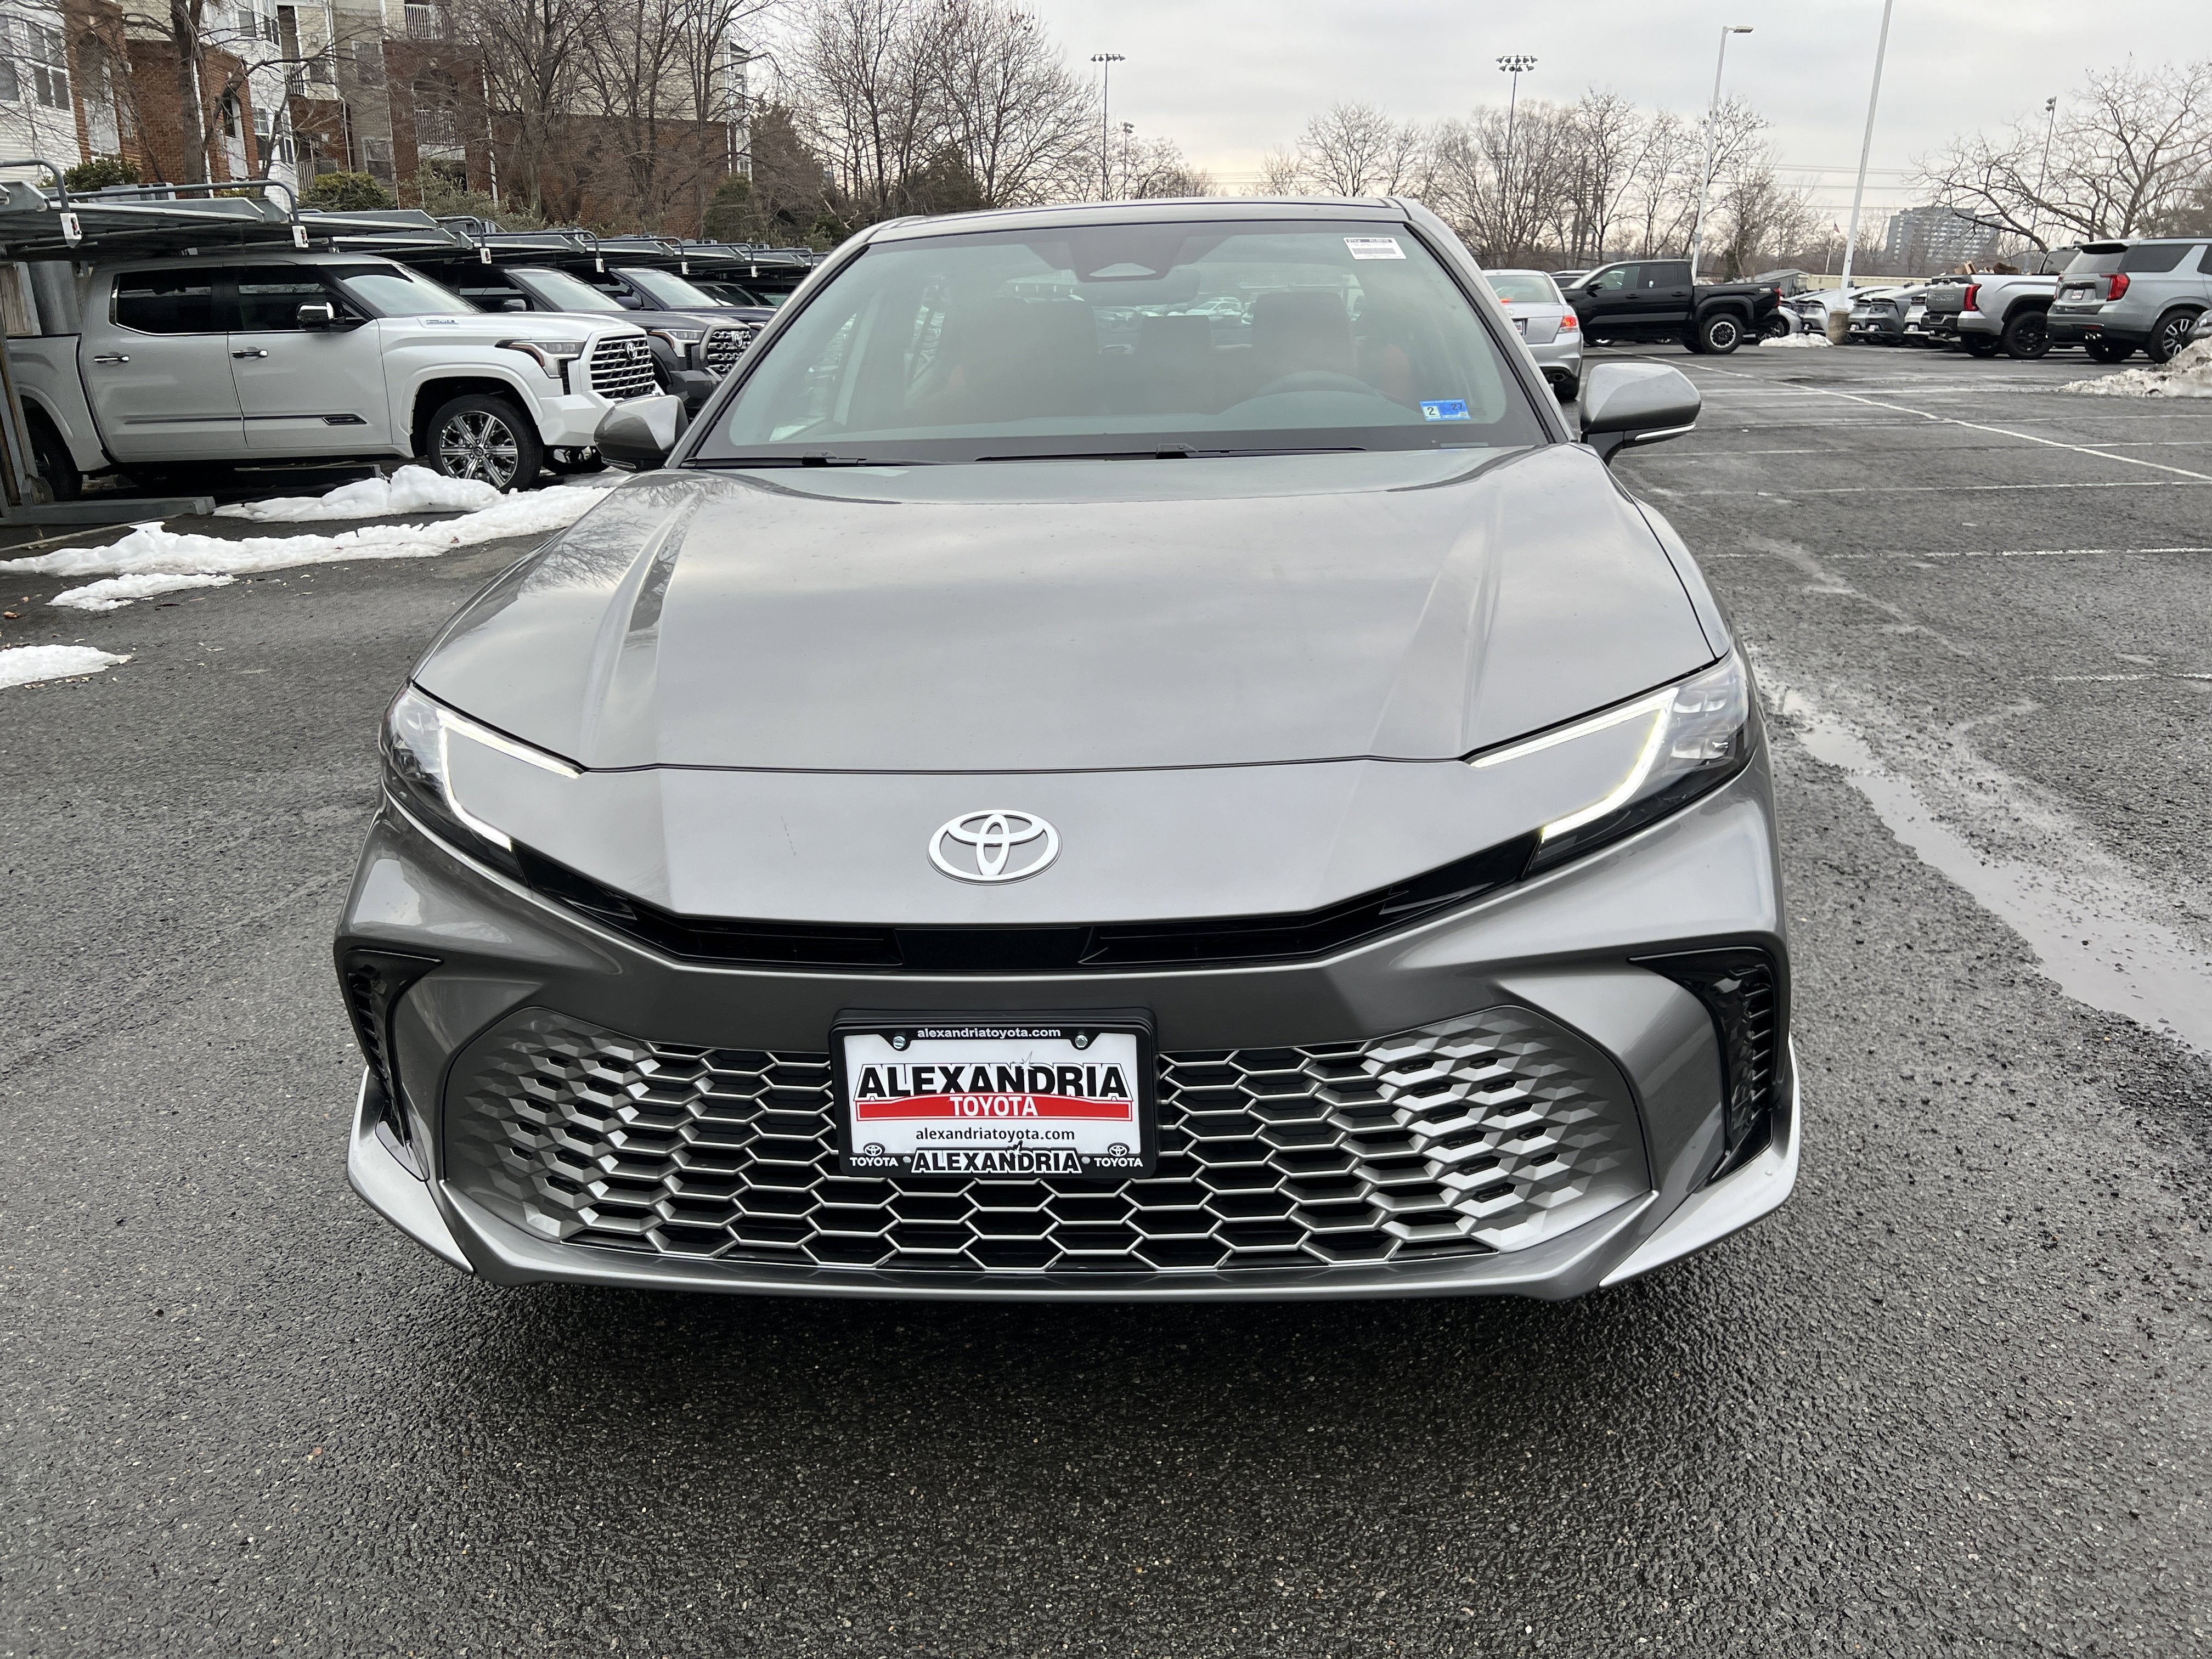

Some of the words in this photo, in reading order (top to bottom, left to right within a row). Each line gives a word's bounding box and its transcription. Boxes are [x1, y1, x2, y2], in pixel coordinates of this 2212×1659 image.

[1427, 407, 1436, 415] 2
[917, 1028, 1060, 1039] alexandriatoyota.com
[855, 1064, 1132, 1099] ALEXANDRIA
[949, 1096, 1039, 1116] TOYOTA
[916, 1127, 1075, 1143] alexandriatoyota.com
[850, 1157, 899, 1167] TOYOTA
[911, 1149, 1082, 1173] ALEXANDRIA
[1094, 1157, 1143, 1167] TOYOTA
